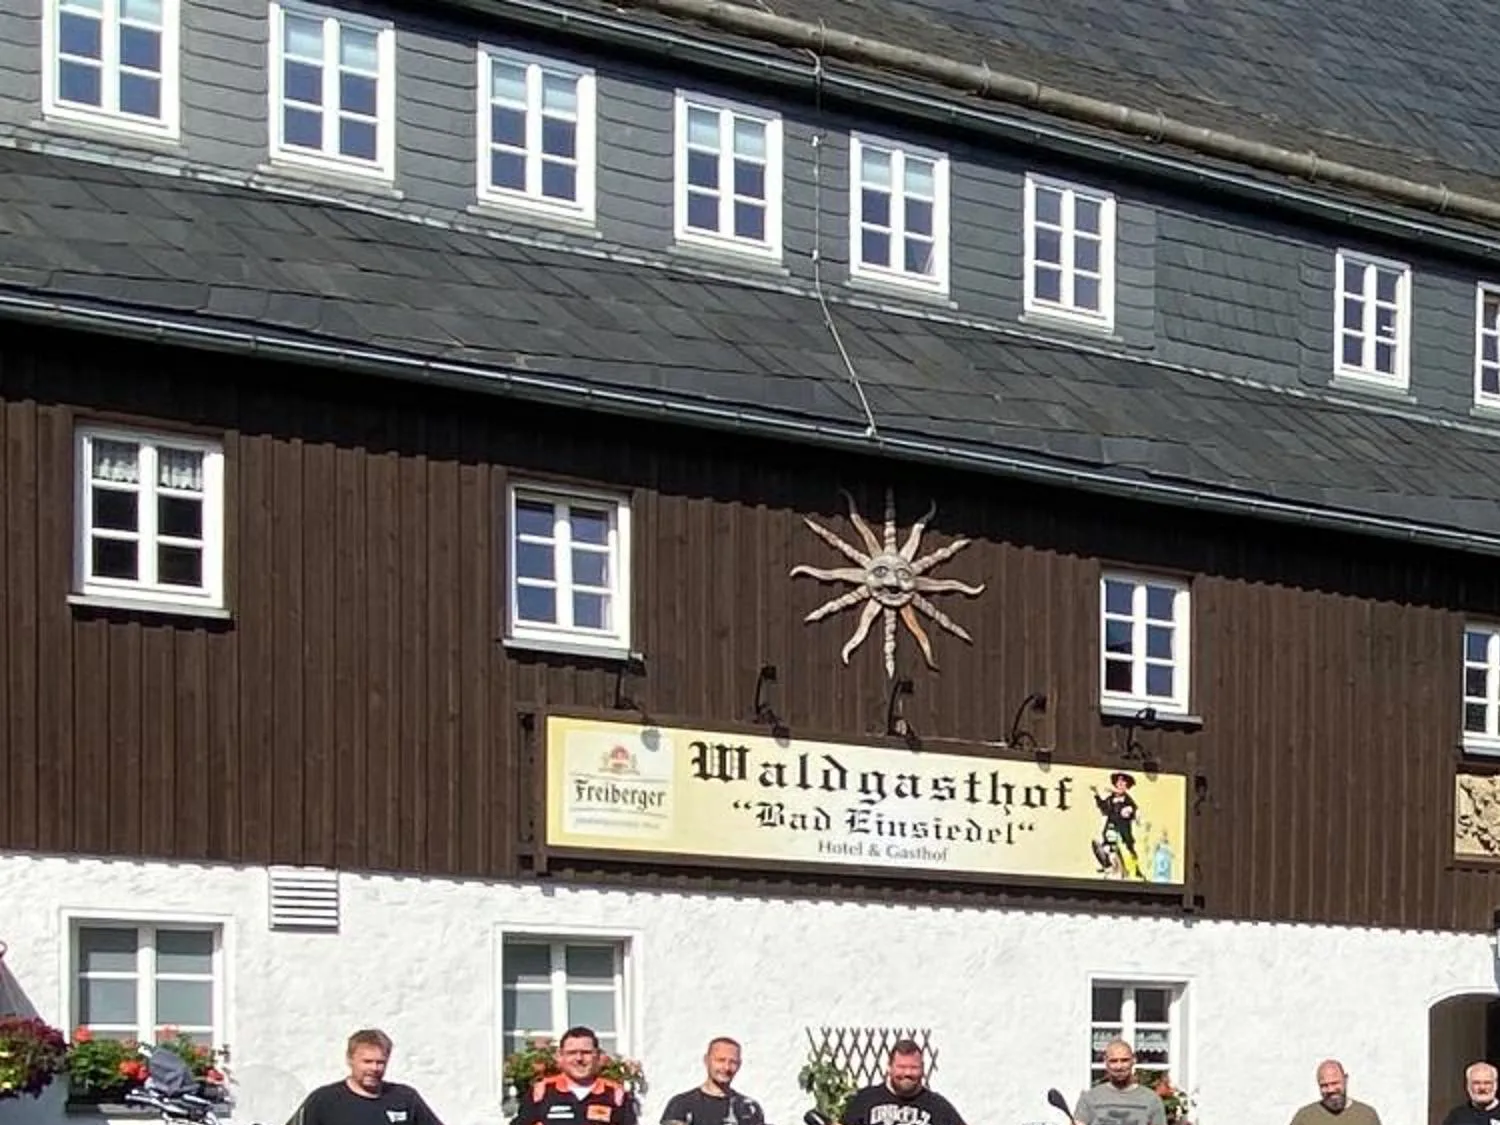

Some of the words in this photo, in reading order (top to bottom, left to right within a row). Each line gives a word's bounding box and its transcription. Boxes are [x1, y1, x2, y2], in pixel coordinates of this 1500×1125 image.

[689, 741, 1073, 815] Waldgasthof
[574, 779, 667, 812] Freiberger
[818, 839, 863, 856] Hotel
[869, 844, 881, 857] &
[885, 844, 949, 862] Gasthof
